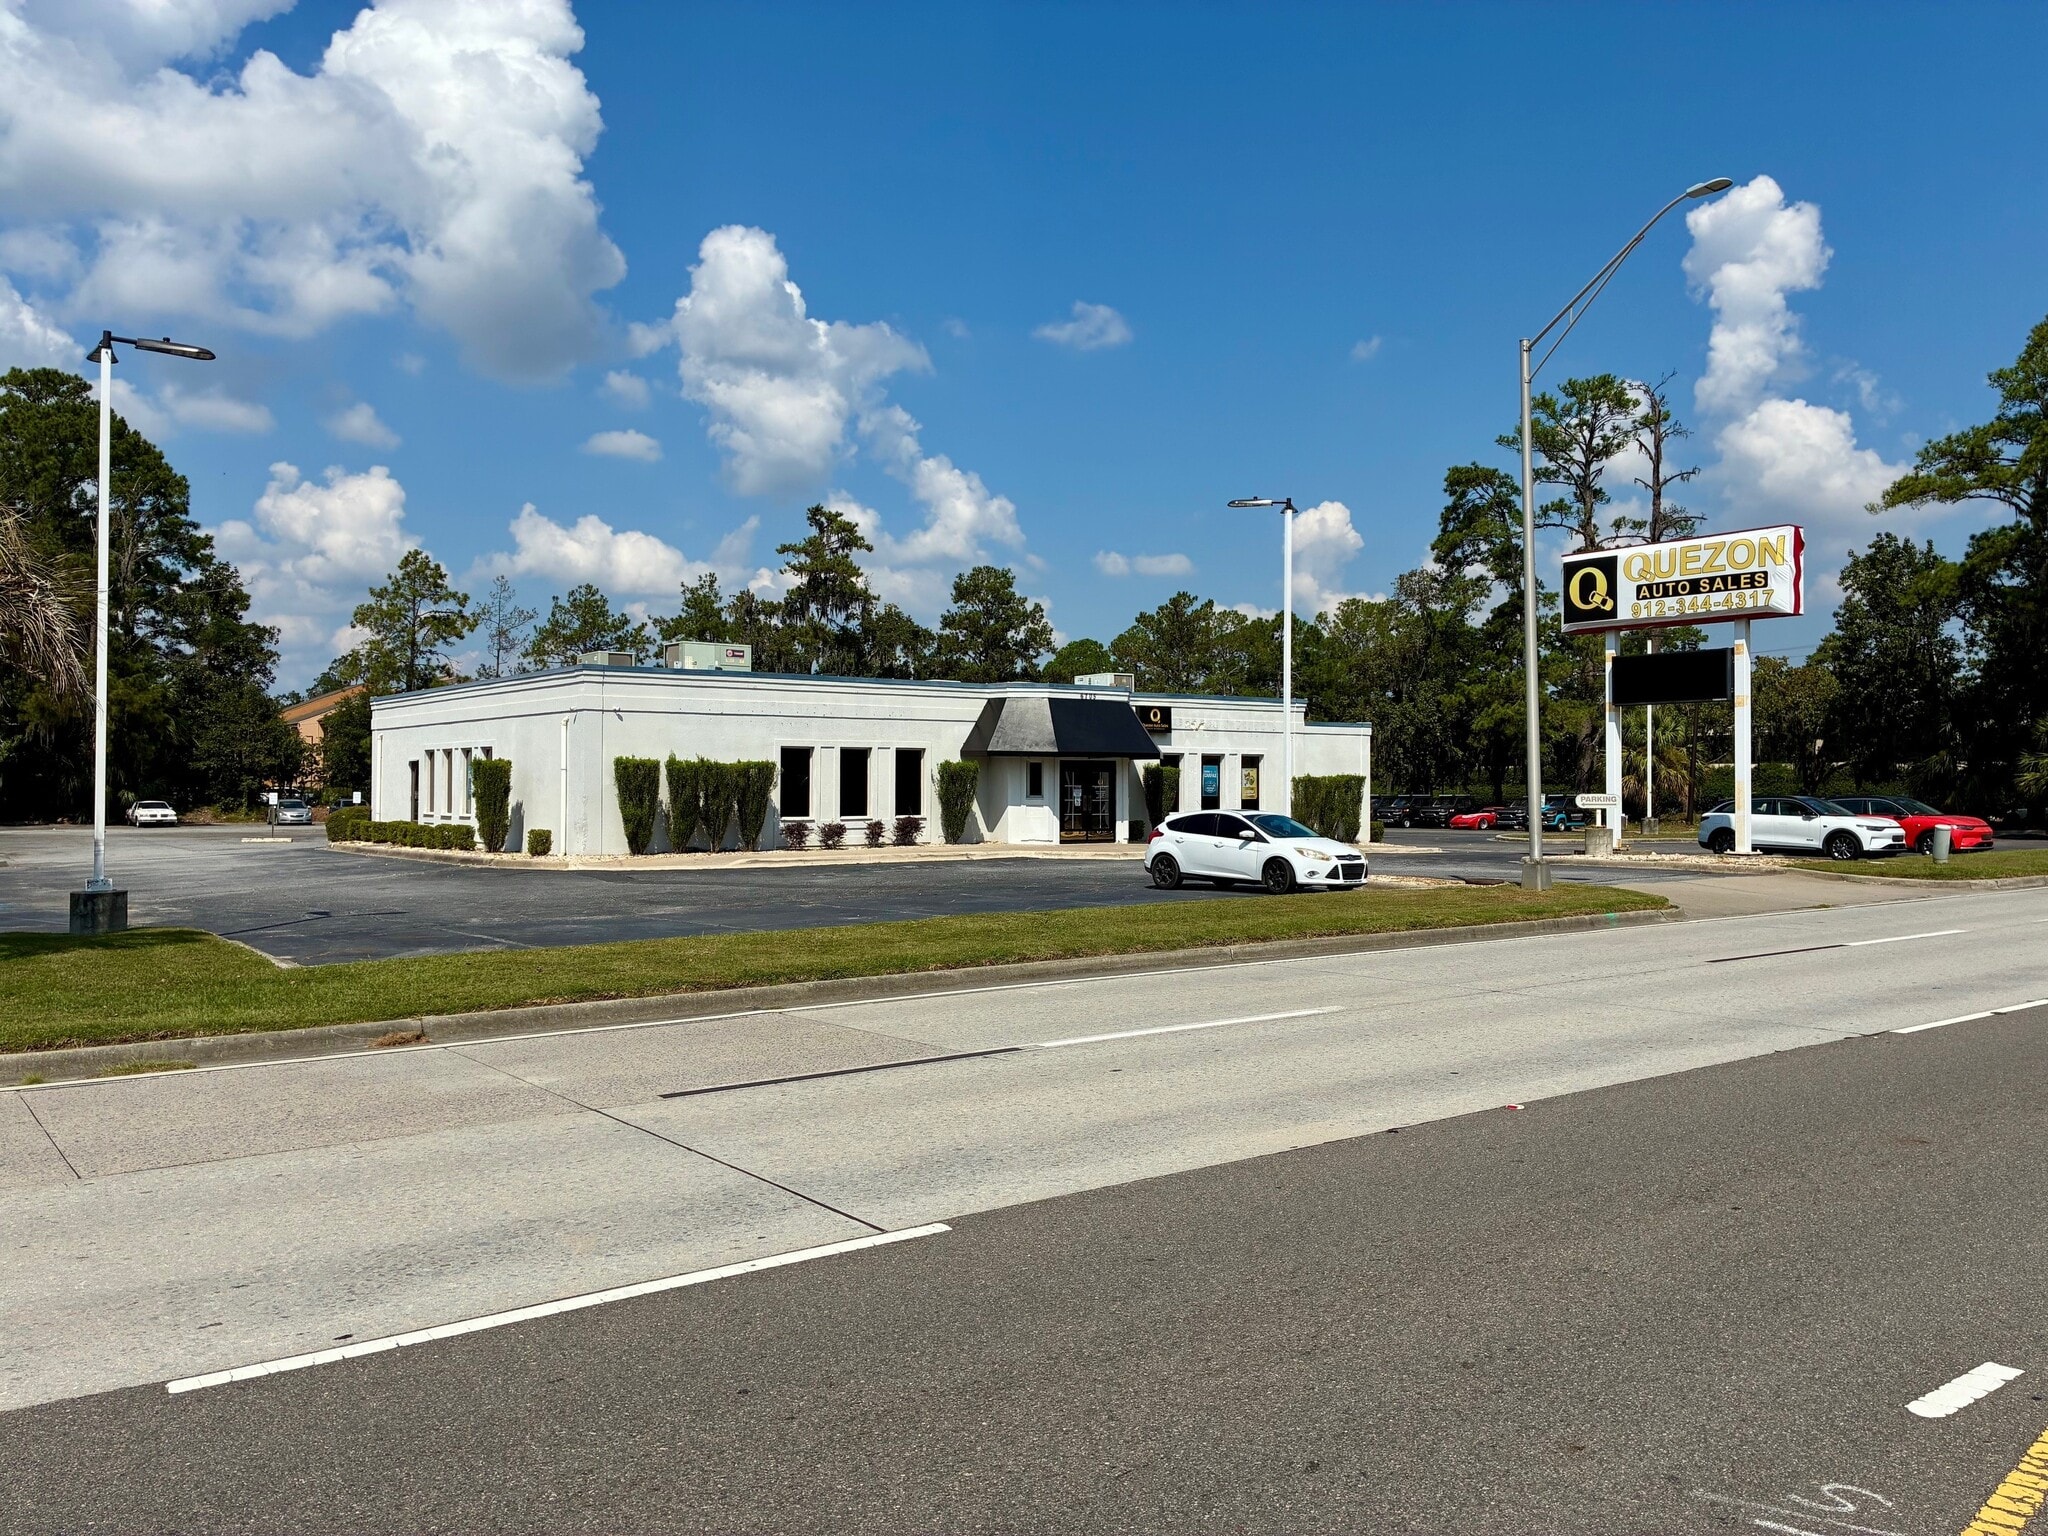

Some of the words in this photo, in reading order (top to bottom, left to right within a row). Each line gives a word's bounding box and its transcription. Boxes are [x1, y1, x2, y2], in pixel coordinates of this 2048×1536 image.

[1623, 535, 1785, 582] QUEZON
[1569, 567, 1614, 611] Q
[1631, 589, 1775, 618] 912-344-4317
[1638, 581, 1690, 599] AUTO
[1699, 572, 1766, 592] SALES
